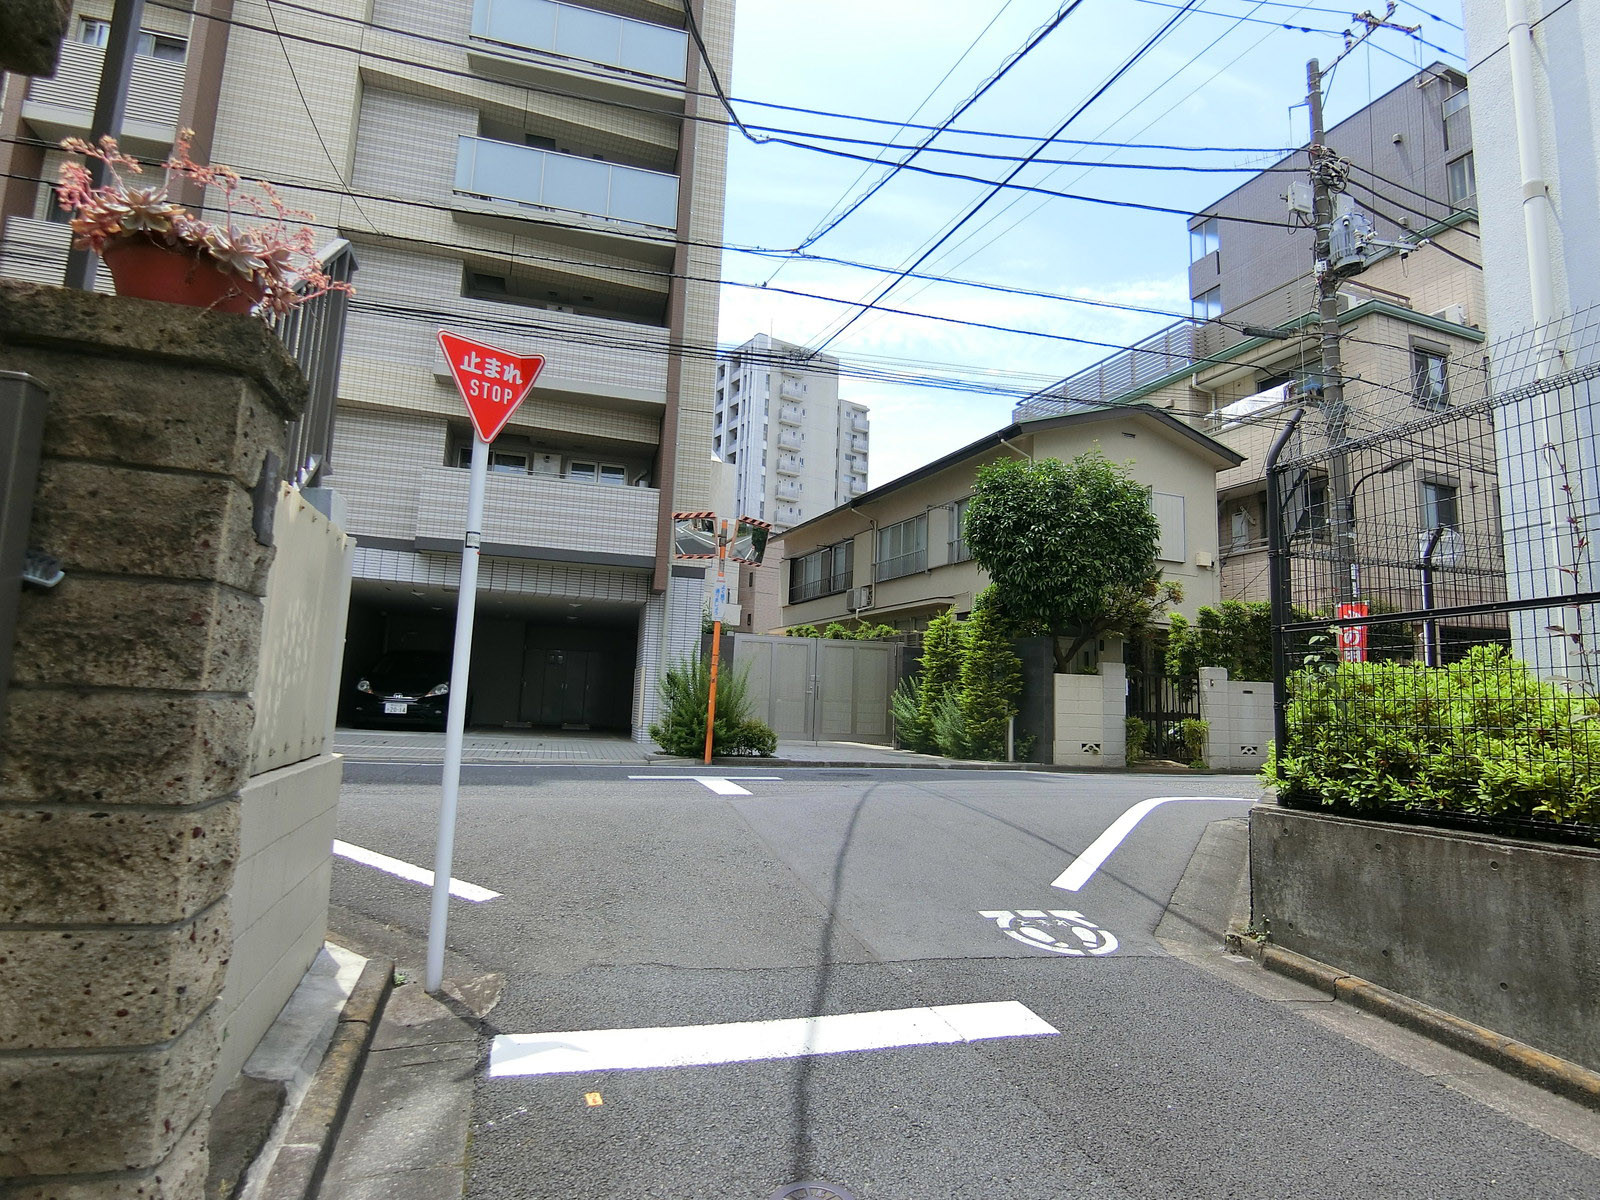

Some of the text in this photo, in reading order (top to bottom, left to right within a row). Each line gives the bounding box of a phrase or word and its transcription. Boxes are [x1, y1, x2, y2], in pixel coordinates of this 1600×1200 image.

[460, 351, 523, 385] 止まれ
[469, 379, 513, 405] STOP
